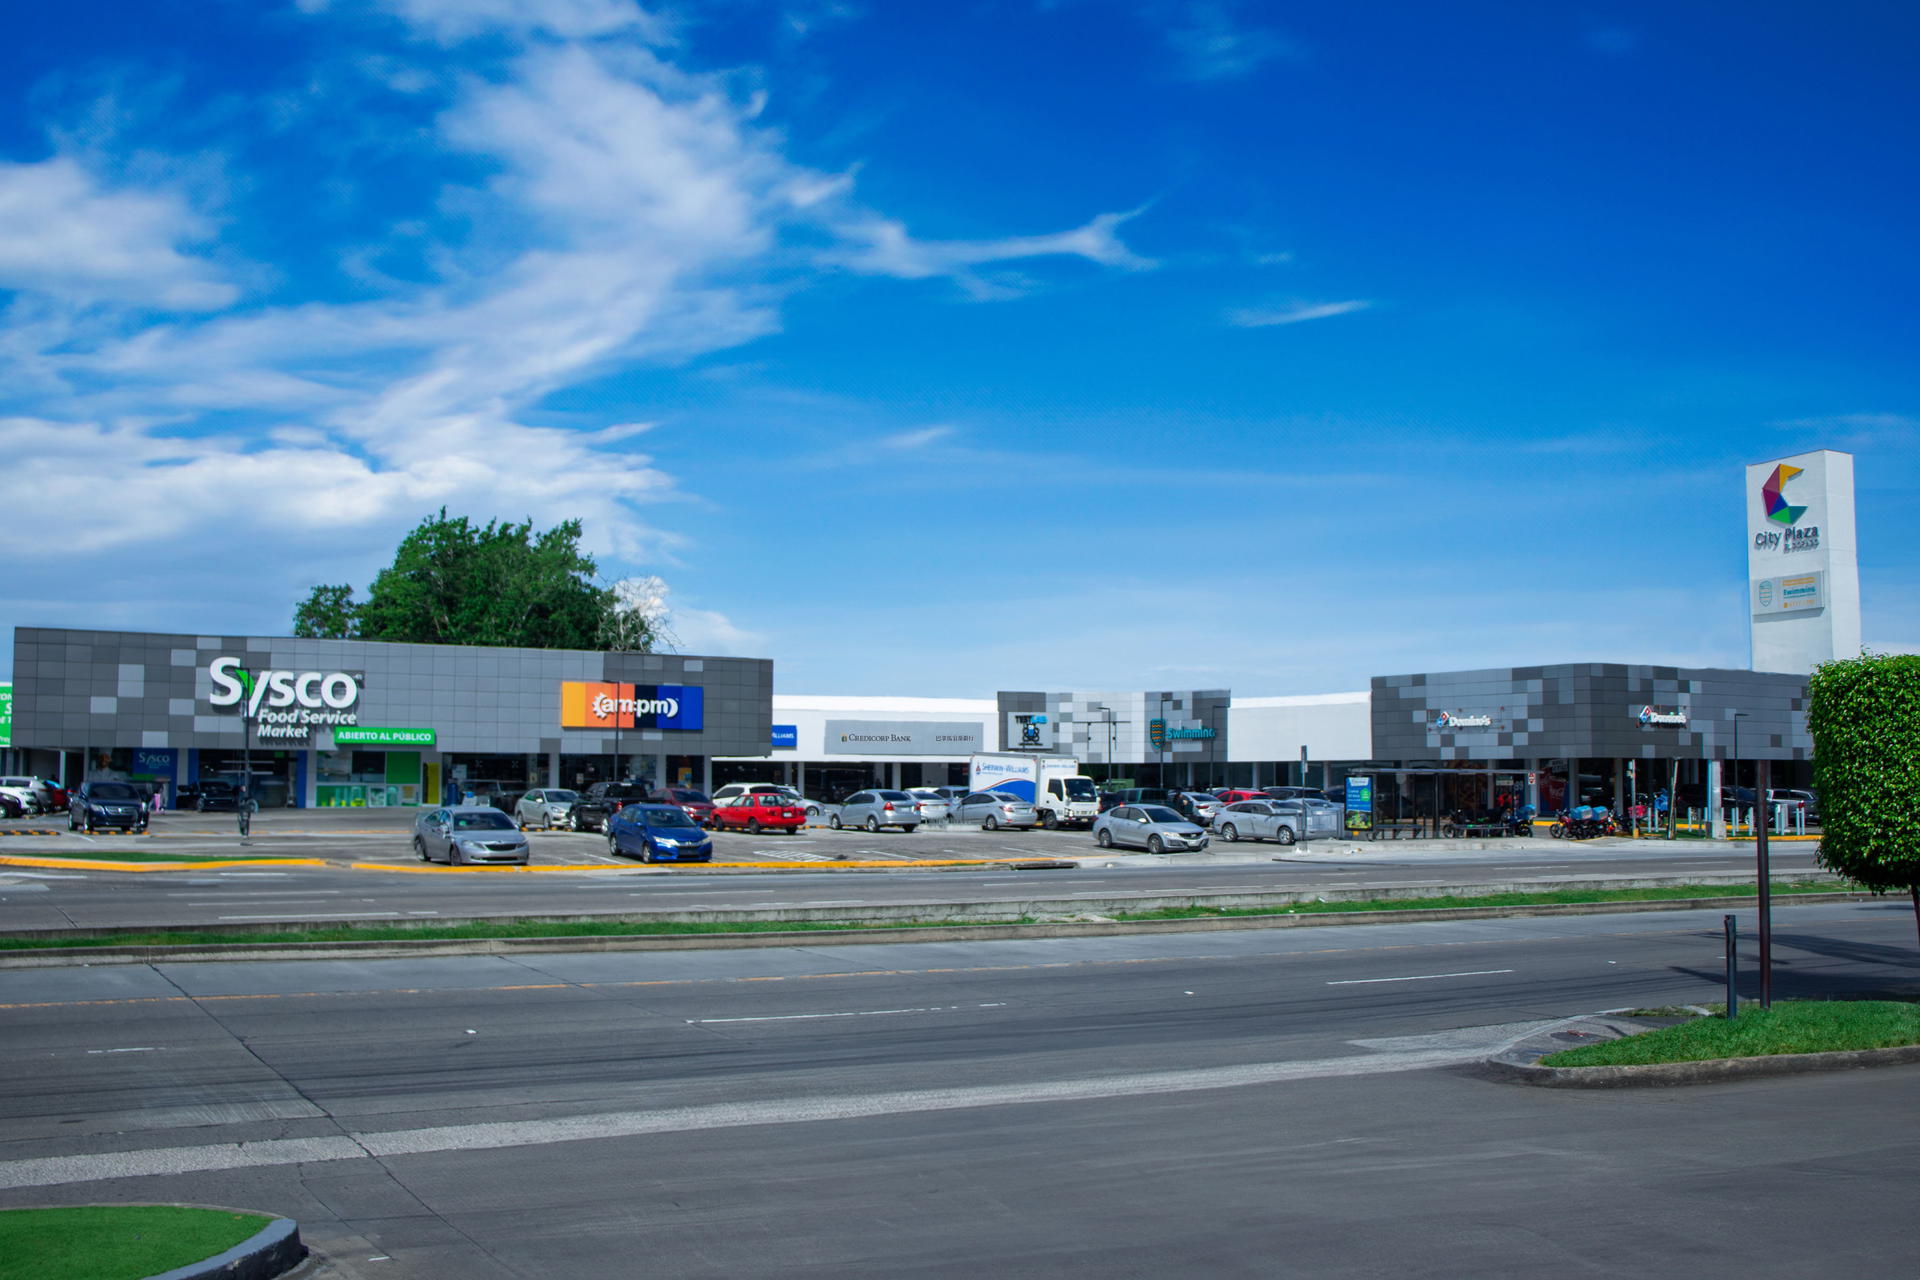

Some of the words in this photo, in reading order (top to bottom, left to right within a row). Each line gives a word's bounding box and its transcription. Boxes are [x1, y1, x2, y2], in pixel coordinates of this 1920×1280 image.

[1755, 531, 1782, 545] City
[1785, 526, 1819, 540] Plaza
[257, 709, 299, 724] Food
[300, 709, 357, 725] Service
[256, 724, 309, 738] Market
[338, 731, 378, 740] ABIERTO
[379, 731, 391, 740] AL
[392, 731, 432, 741] PÚBLICO
